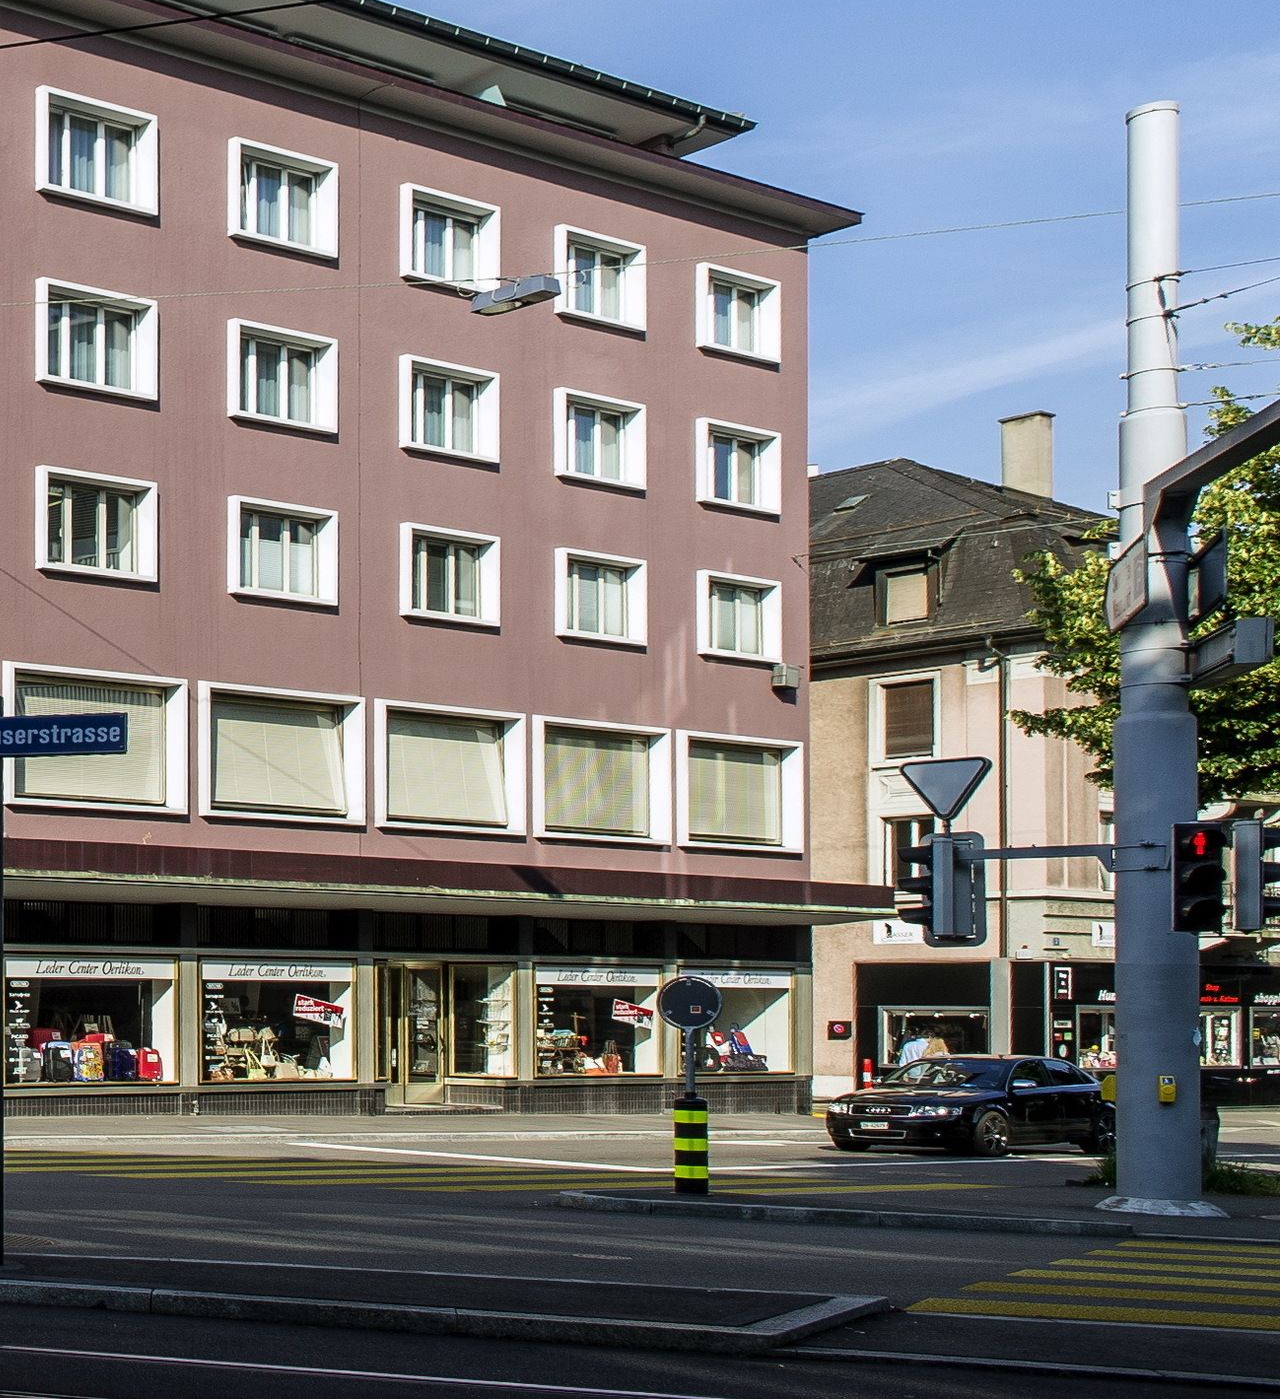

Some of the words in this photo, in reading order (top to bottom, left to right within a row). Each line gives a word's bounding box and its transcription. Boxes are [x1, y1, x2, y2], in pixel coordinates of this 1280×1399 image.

[36, 960, 65, 975] Leder
[68, 960, 98, 975] Center
[102, 960, 145, 976] Oerlikon
[228, 963, 254, 977] Leder
[257, 963, 285, 977] Center
[288, 963, 326, 978] Oerlikon
[297, 999, 314, 1007] stark
